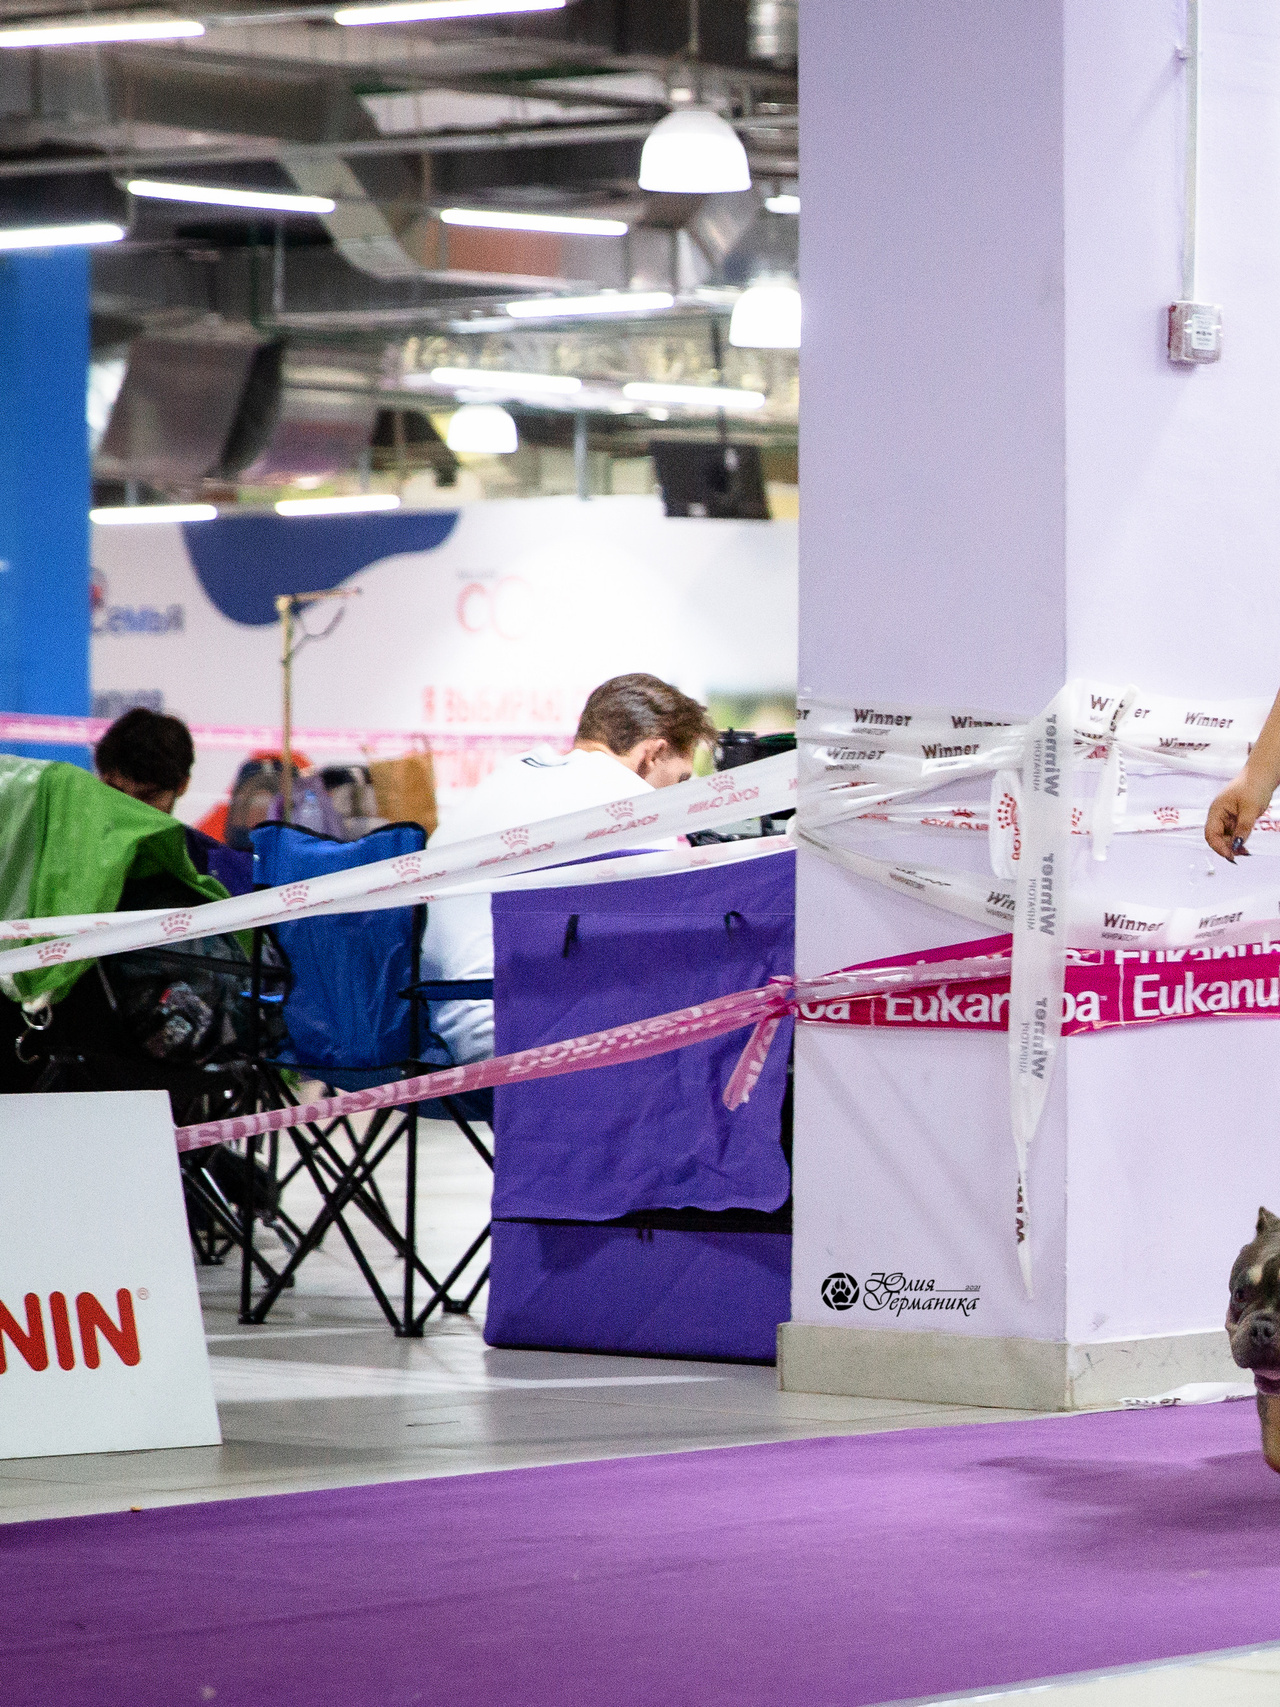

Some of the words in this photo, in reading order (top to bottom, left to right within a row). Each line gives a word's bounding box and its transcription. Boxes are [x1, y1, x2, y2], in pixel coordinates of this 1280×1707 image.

[1090, 694, 1151, 719] Wier
[853, 708, 912, 727] Winner
[1184, 712, 1234, 729] Winner
[827, 747, 886, 761] Winner
[921, 743, 981, 760] Winner
[986, 891, 1016, 911] Win
[1103, 912, 1163, 932] Winner
[1198, 911, 1244, 930] Winner
[0, 1287, 141, 1375] NIN
